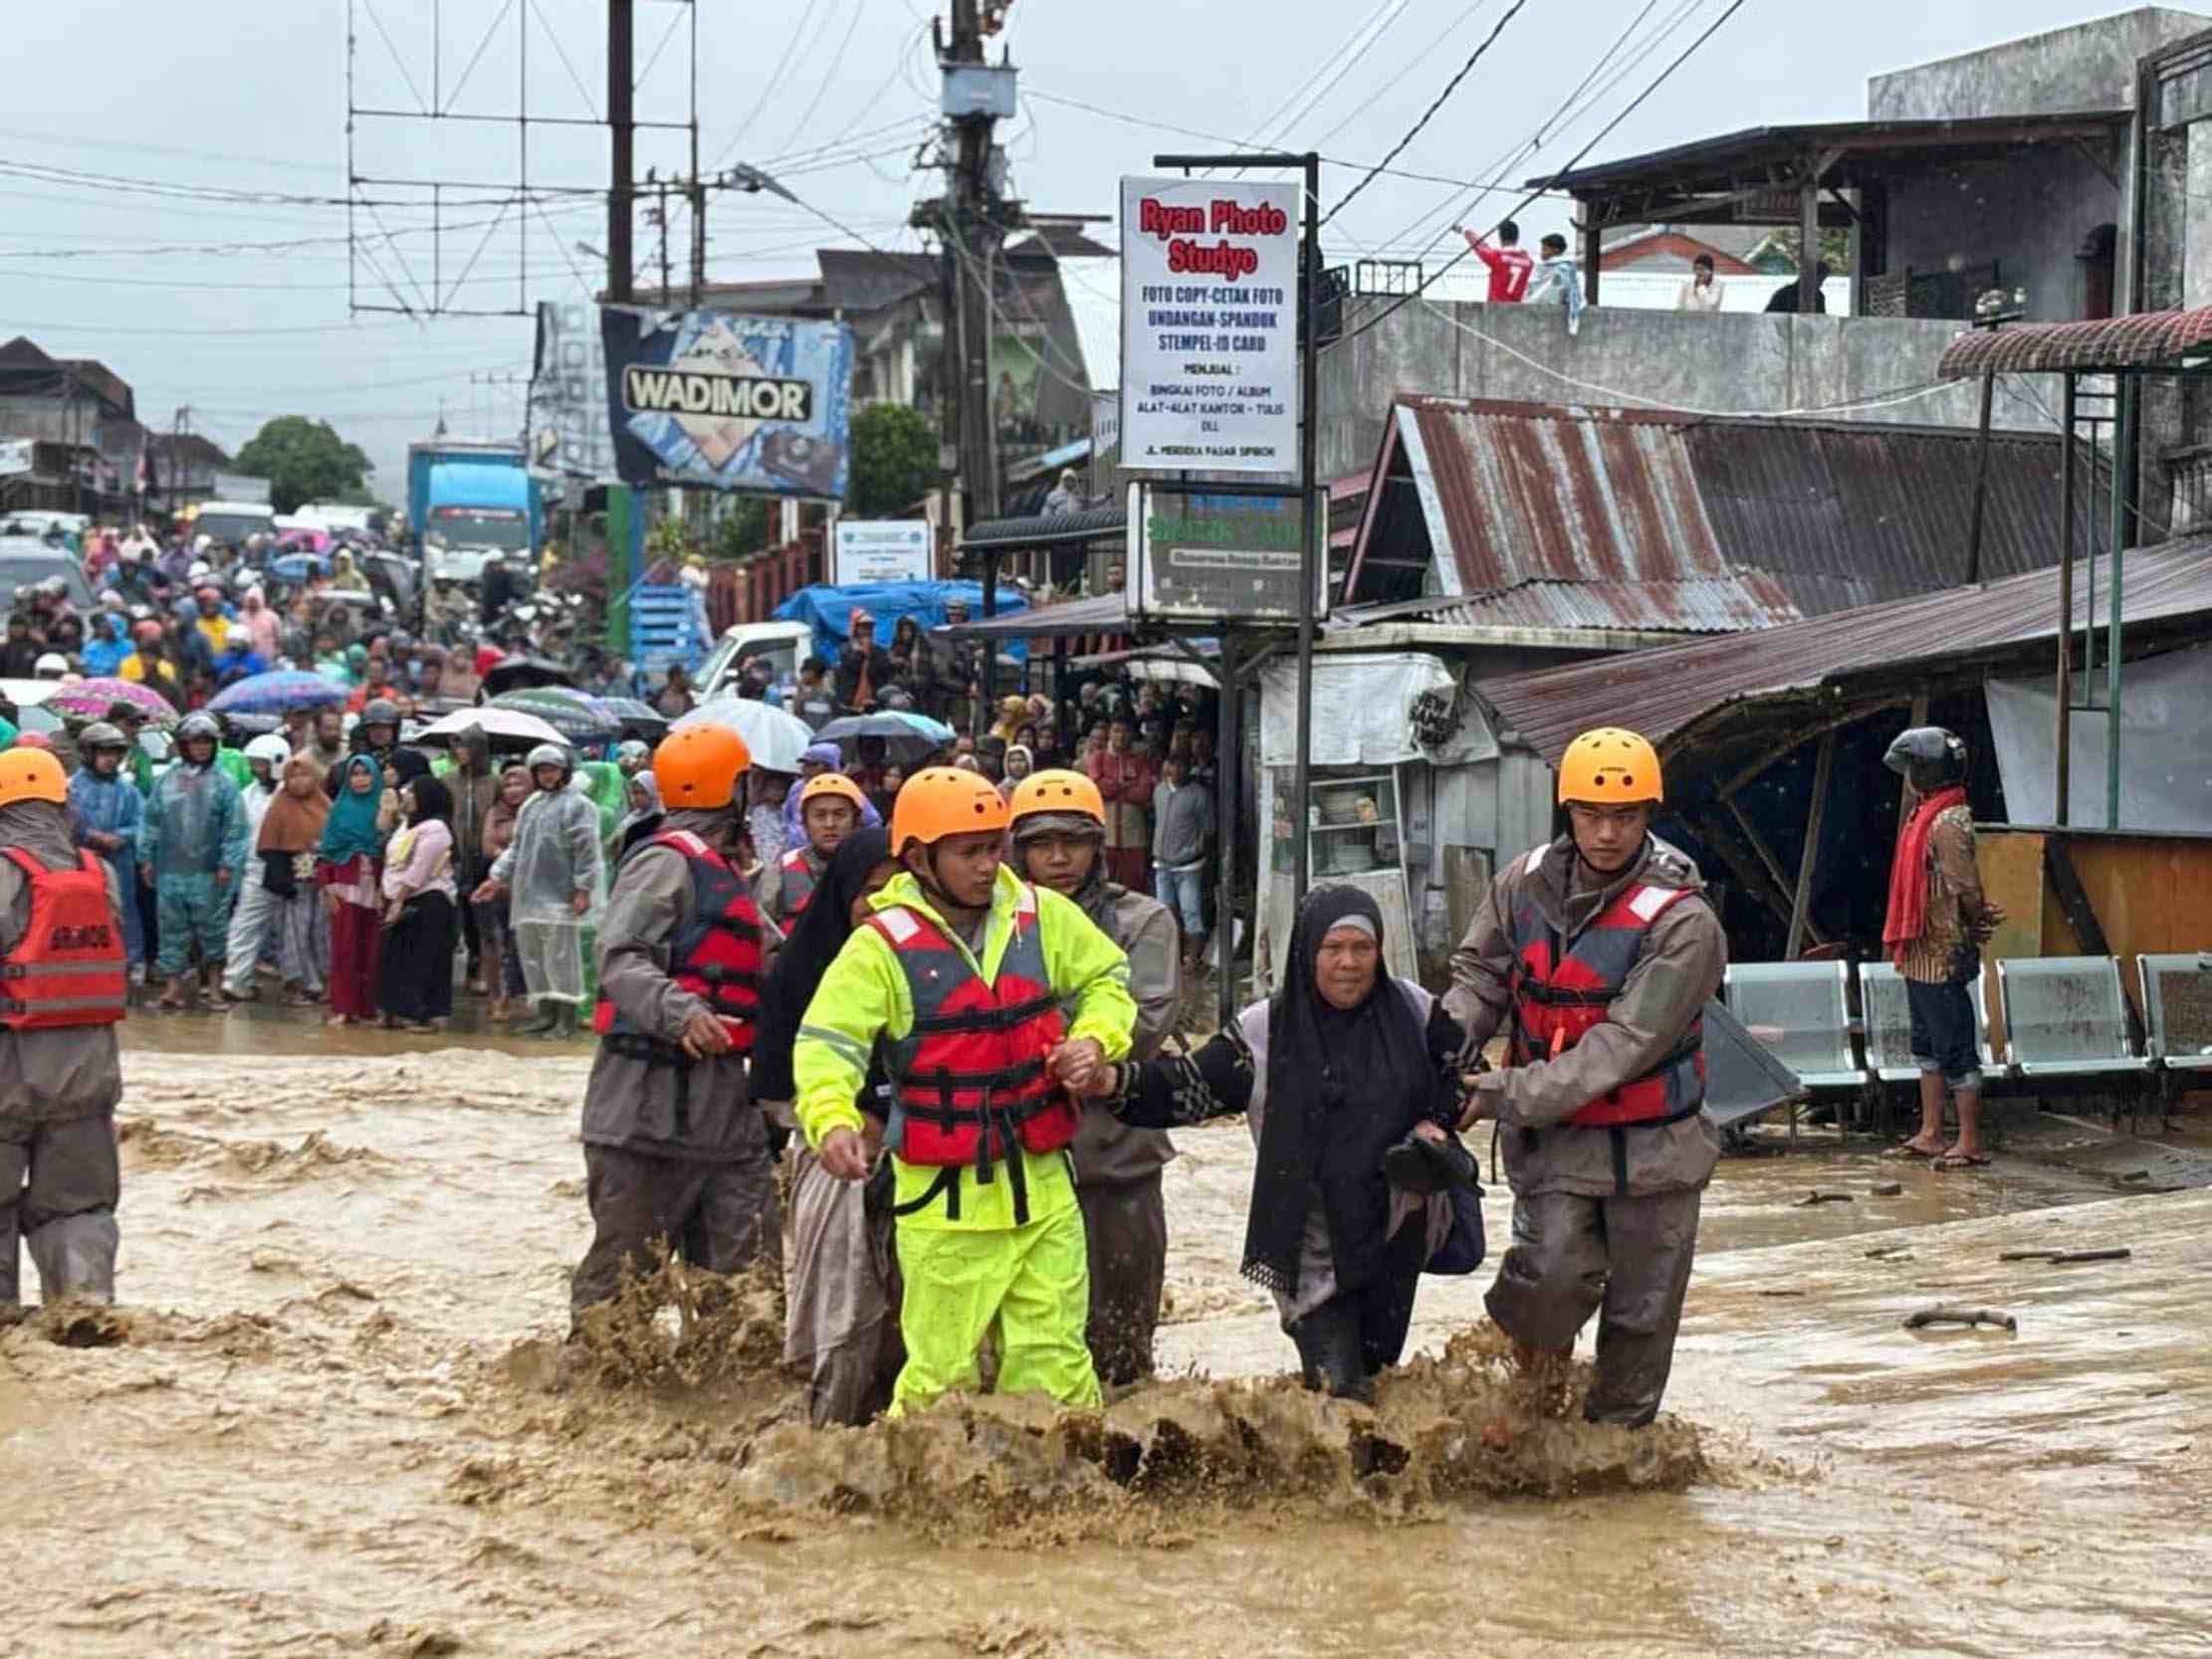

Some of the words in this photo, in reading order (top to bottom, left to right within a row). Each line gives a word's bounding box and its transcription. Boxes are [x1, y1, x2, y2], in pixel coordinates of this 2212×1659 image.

[1140, 198, 1206, 240] Ryan
[1211, 199, 1287, 235] Photo
[1168, 238, 1258, 282] Studyo
[1506, 266, 1522, 294] 7
[1142, 286, 1173, 303] FOTO
[1176, 287, 1250, 304] COPY-CETAK
[1252, 288, 1283, 305] FOTO
[1148, 311, 1277, 328] UNDANGAN-SPANDUK
[1159, 334, 1229, 351] STEMPEL-ID
[1232, 335, 1266, 351] CARD
[629, 371, 805, 420] WADIMOR
[1150, 384, 1193, 396] BINGKAI
[1196, 385, 1225, 396] FOTO
[1236, 386, 1271, 397] ALBUM
[1137, 402, 1197, 414] ALAT-ALAT
[1201, 403, 1245, 414] KANTOR
[1255, 403, 1285, 415] TULIS
